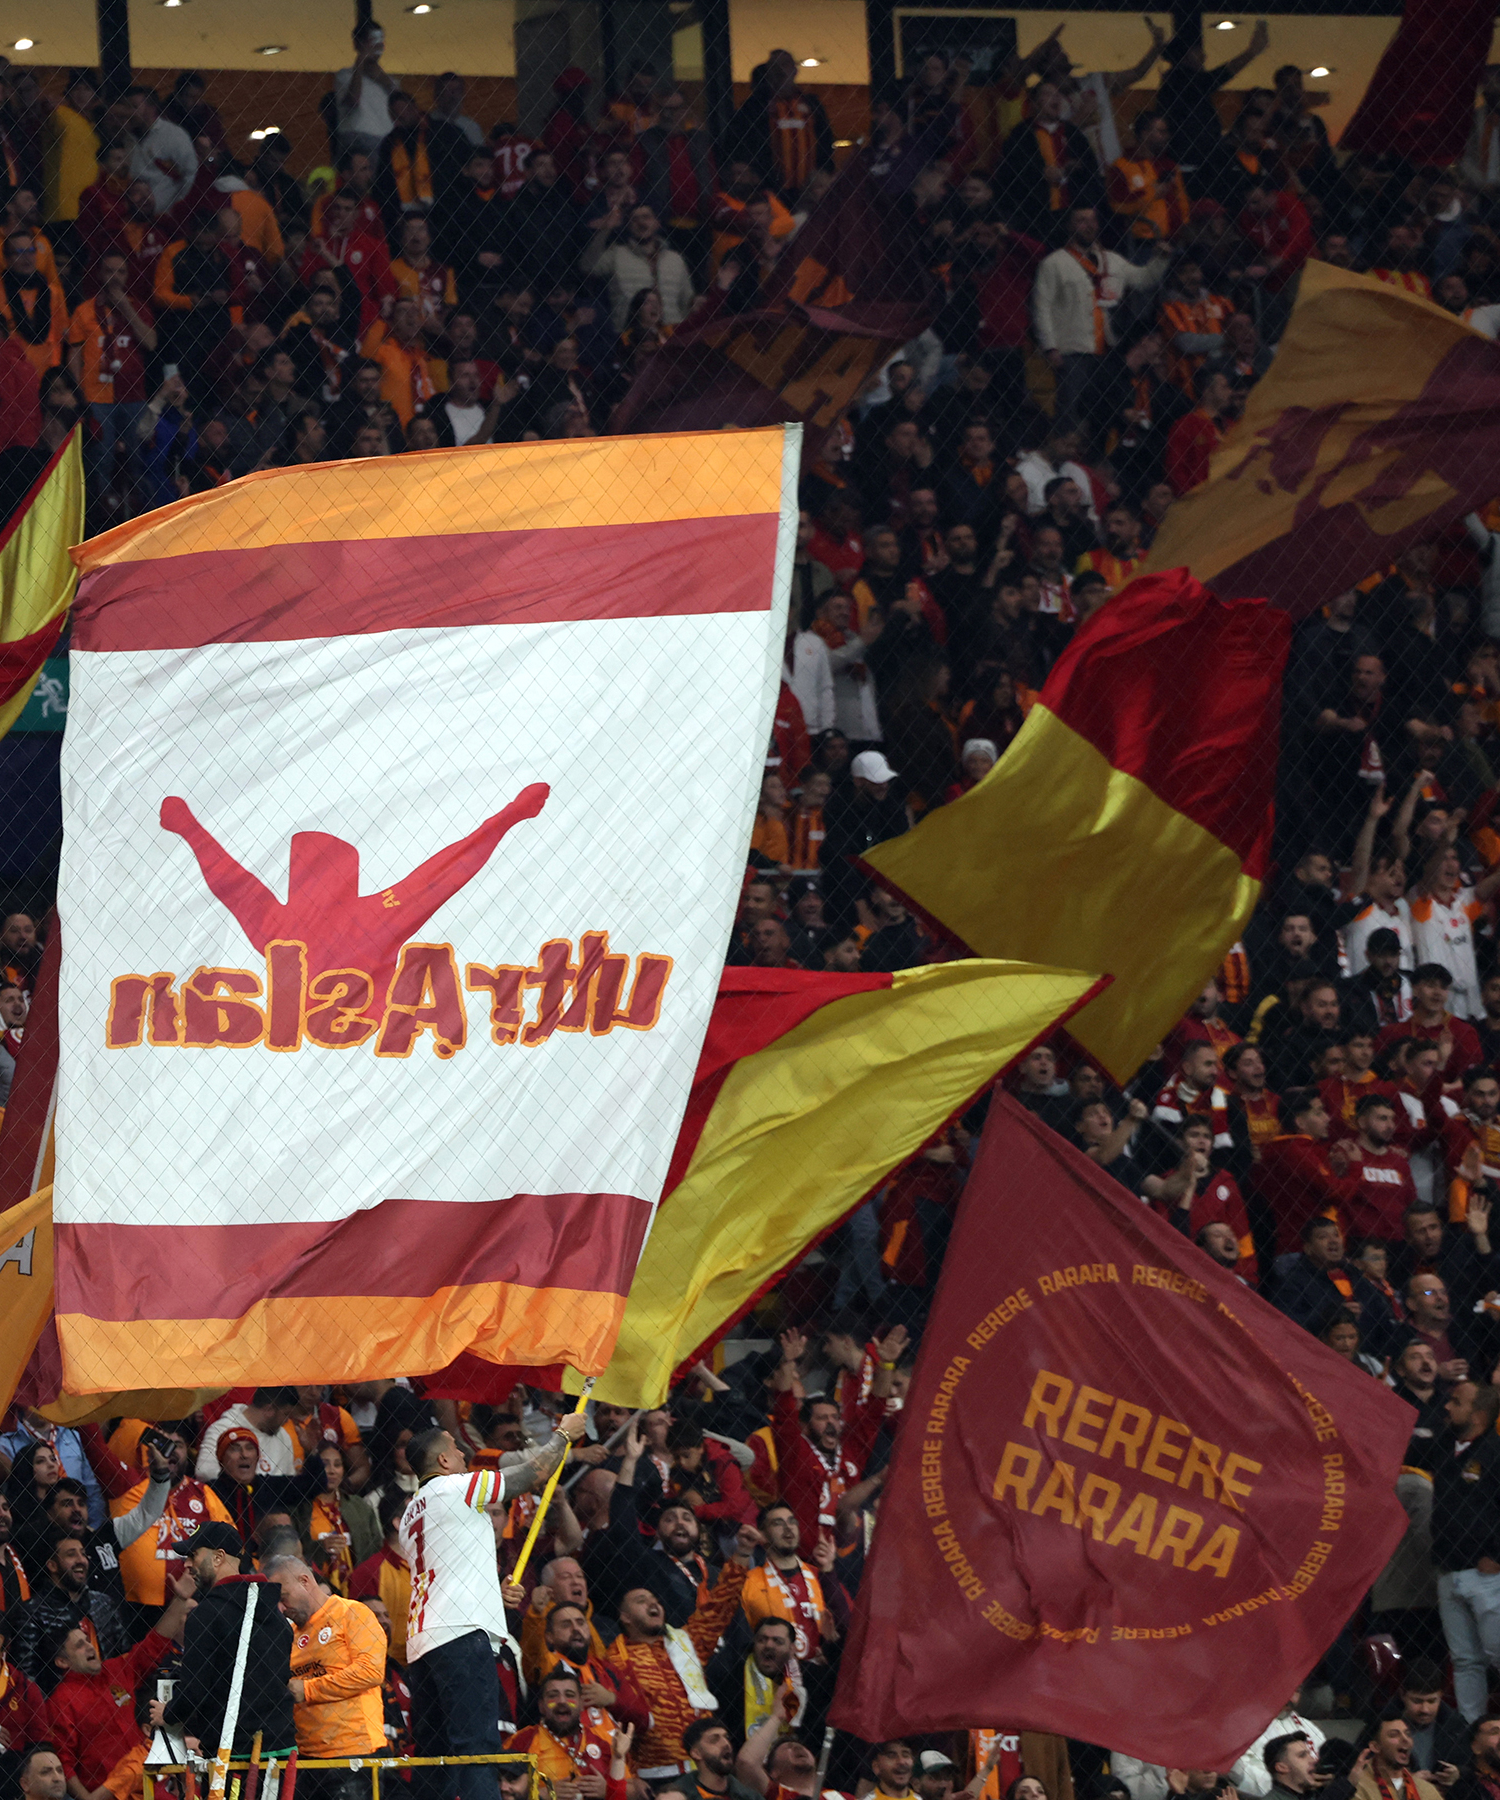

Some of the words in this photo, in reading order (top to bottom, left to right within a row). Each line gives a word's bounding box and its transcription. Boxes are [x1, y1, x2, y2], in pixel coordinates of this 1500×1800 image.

[966, 1287, 1034, 1350] RERERE
[1038, 1263, 1120, 1296] RARARA
[926, 1356, 971, 1433] RARARA
[921, 1439, 948, 1518] RERERE
[1022, 1369, 1263, 1513] RERERE
[992, 1441, 1241, 1578] RARARA
[1319, 1453, 1345, 1531] RARARA
[932, 1520, 986, 1601] RARARA
[291, 1659, 322, 1677] ASIFIK
